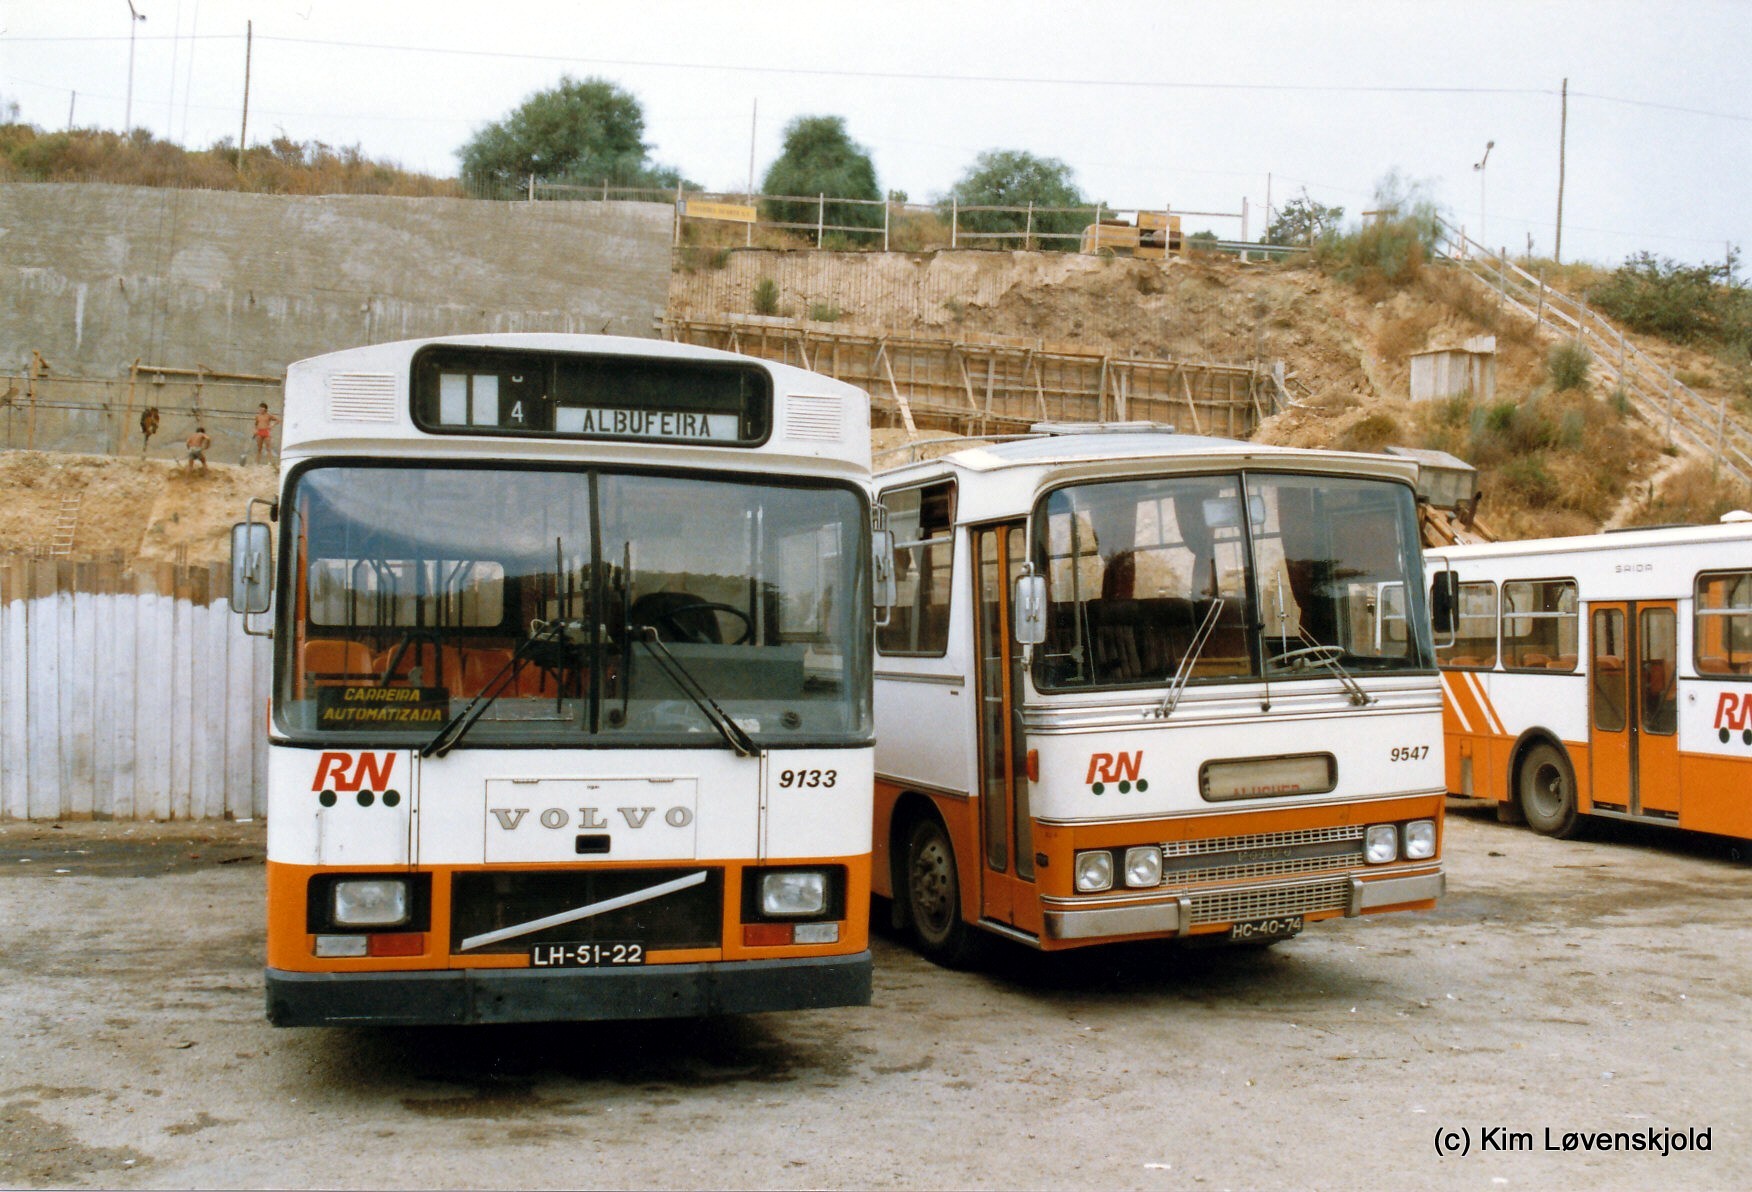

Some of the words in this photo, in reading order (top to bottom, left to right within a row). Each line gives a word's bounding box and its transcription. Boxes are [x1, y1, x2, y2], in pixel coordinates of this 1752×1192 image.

[510, 400, 524, 424] 4
[582, 408, 711, 437] ALBUFEIRA
[344, 687, 420, 702] CARREIRA
[323, 707, 442, 721] AUTOMATIZADA
[1390, 745, 1430, 763] 9547
[311, 752, 397, 792] RN
[779, 769, 838, 789] 9133
[1085, 750, 1144, 785] RN
[490, 806, 693, 831] VOLVO
[533, 944, 642, 966] LH-51-22
